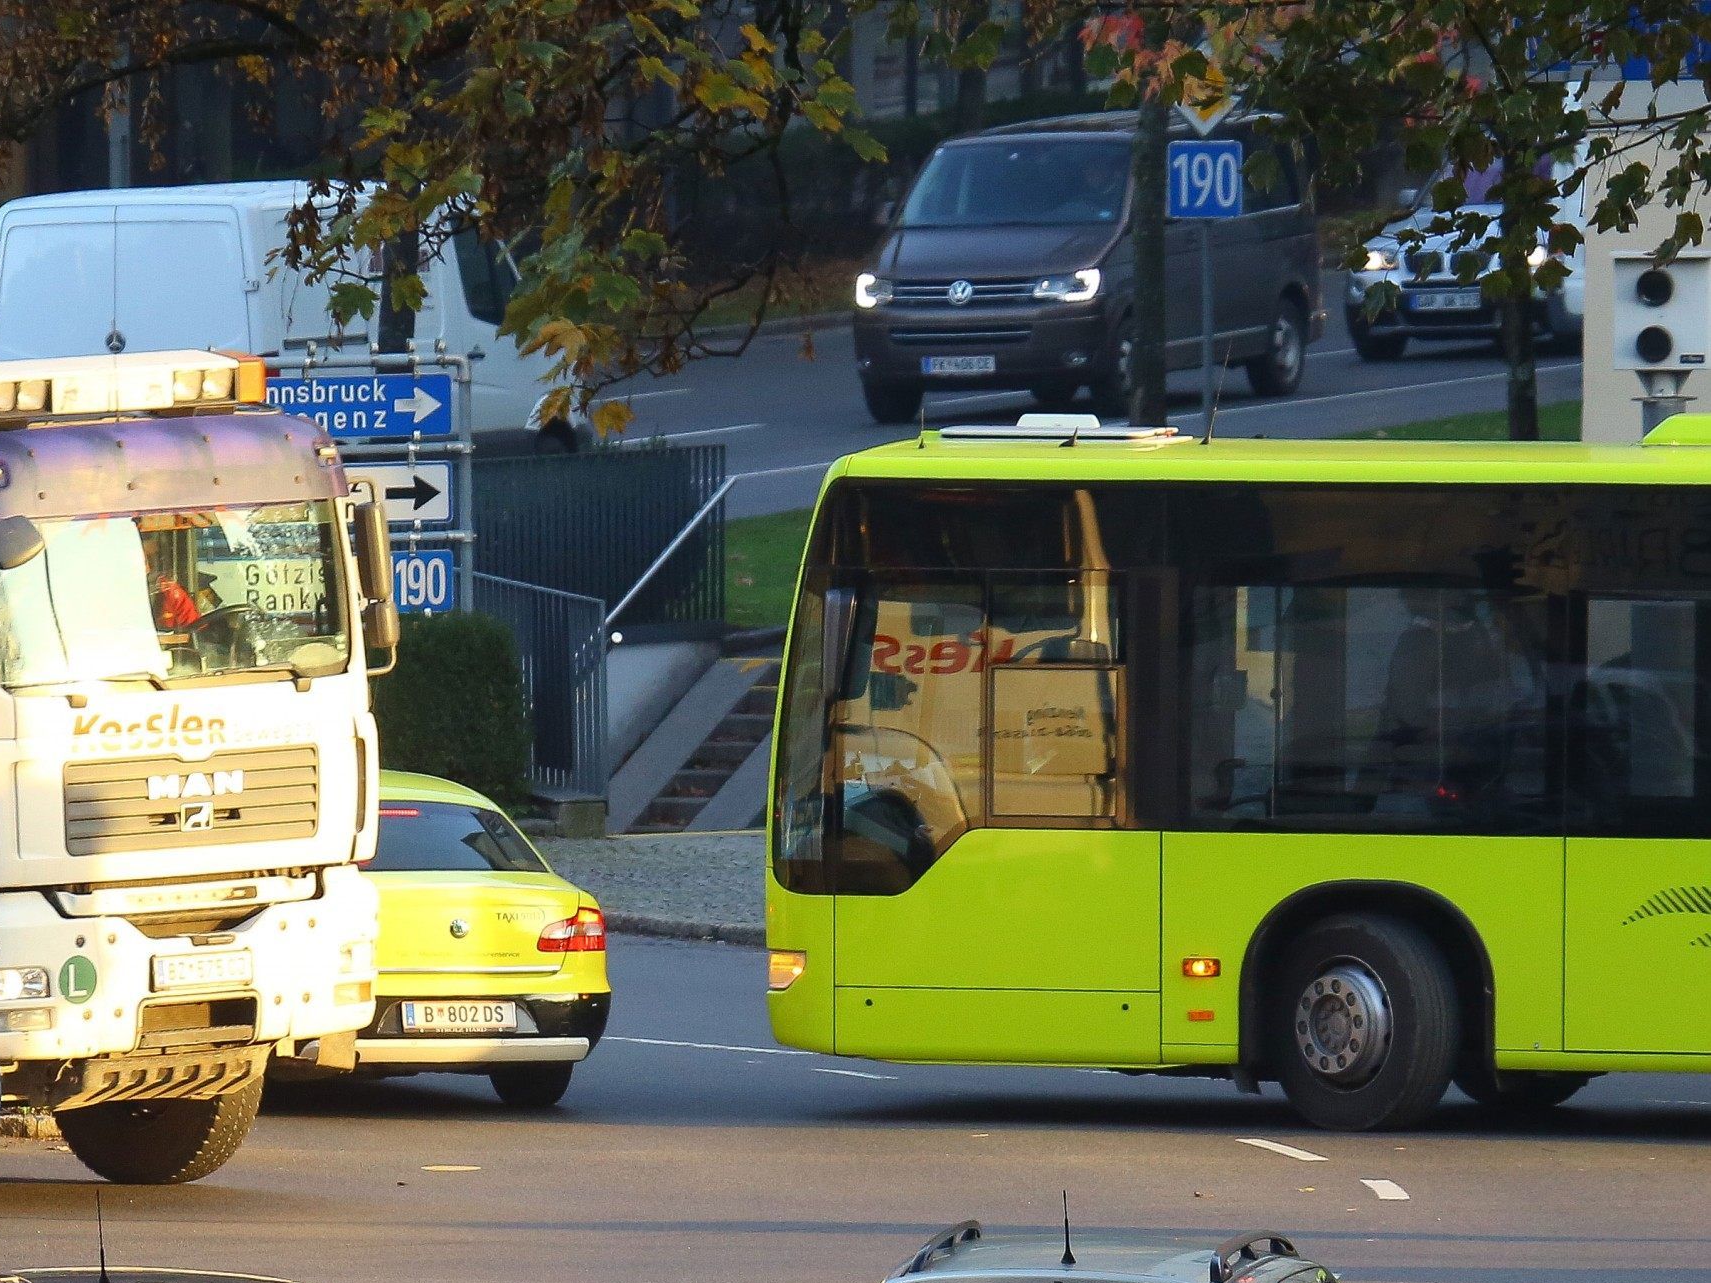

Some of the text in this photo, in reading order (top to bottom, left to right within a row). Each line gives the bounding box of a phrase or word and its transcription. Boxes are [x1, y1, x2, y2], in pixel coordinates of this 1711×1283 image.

[1172, 152, 1239, 208] 190
[265, 378, 387, 405] nnsbruck
[298, 410, 387, 432] genz
[395, 558, 446, 606] 190
[147, 769, 245, 801] MAN
[68, 963, 88, 998] L
[424, 1005, 504, 1023] B 802 DS
